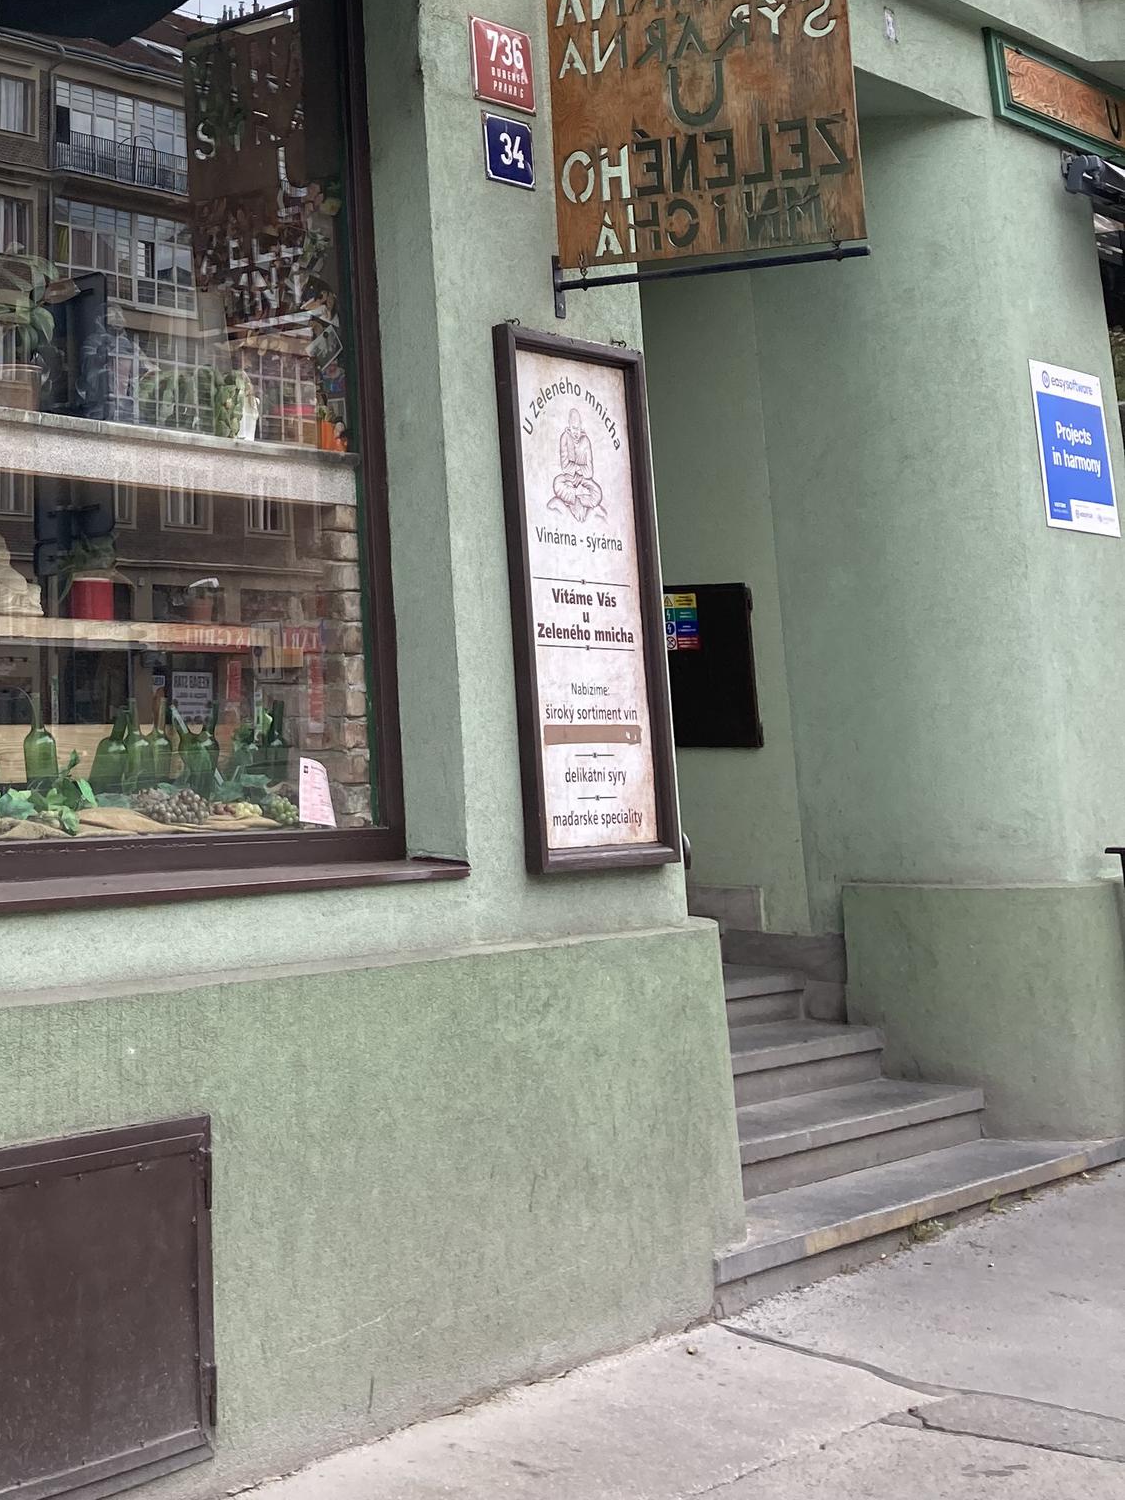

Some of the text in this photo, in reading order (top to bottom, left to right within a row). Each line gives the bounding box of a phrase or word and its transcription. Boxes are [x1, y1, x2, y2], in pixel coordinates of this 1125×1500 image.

[486, 29, 524, 69] 736
[493, 80, 518, 97] PRAHA
[499, 132, 525, 170] 34
[522, 375, 621, 451] U Zeleného mnicha
[1055, 420, 1092, 446] Projects
[1052, 446, 1101, 478] in harmony
[535, 526, 577, 547] Vinárna
[586, 530, 623, 553] sýrárna
[552, 587, 617, 608] Vítáme Vás
[582, 611, 590, 623] u
[537, 622, 634, 643] Zeleného mnicha
[545, 703, 638, 723] široký sortiment vín
[565, 767, 627, 786] delikátní sýry
[553, 808, 643, 829] maďarské speciality
